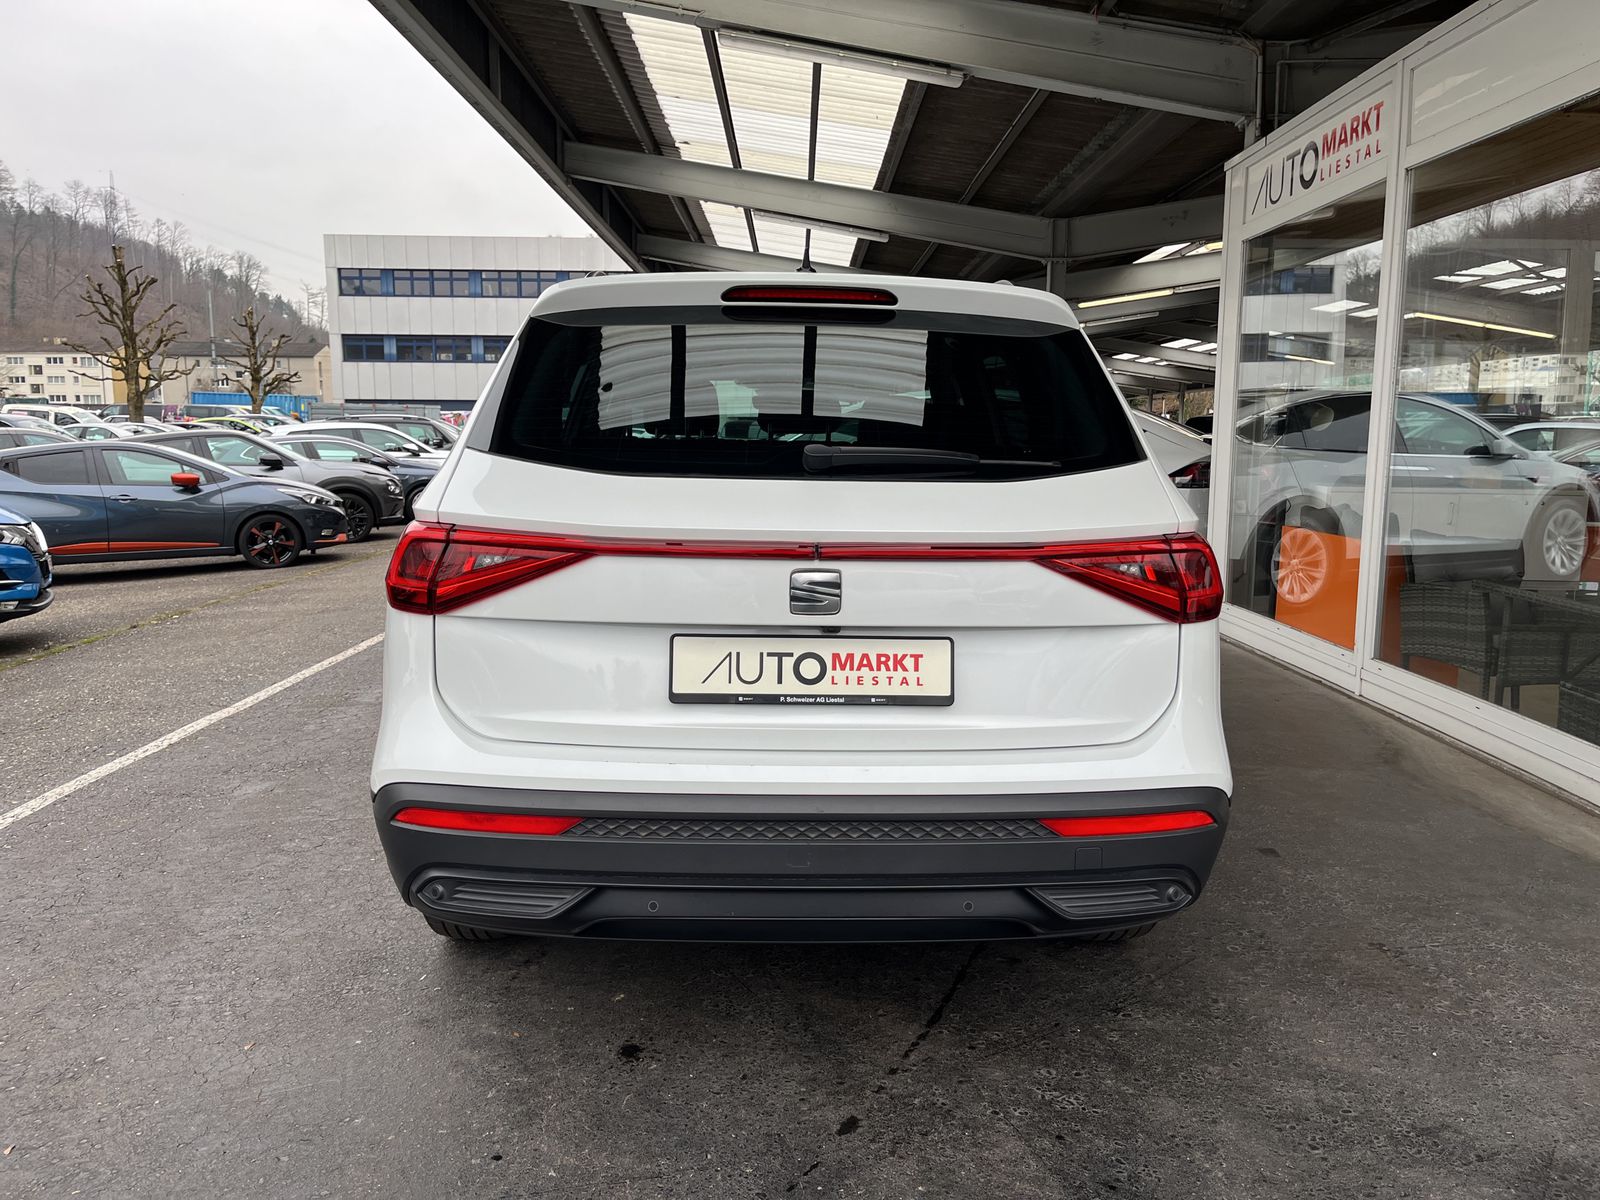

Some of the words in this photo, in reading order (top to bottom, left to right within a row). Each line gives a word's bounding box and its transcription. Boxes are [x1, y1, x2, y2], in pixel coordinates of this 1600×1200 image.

[1251, 141, 1319, 215] AUTO
[1321, 100, 1384, 160] MARKT
[1320, 139, 1381, 182] LIESTAL
[701, 651, 828, 686] AUTO
[831, 652, 924, 673] MARKT
[831, 675, 924, 687] LIESTAL
